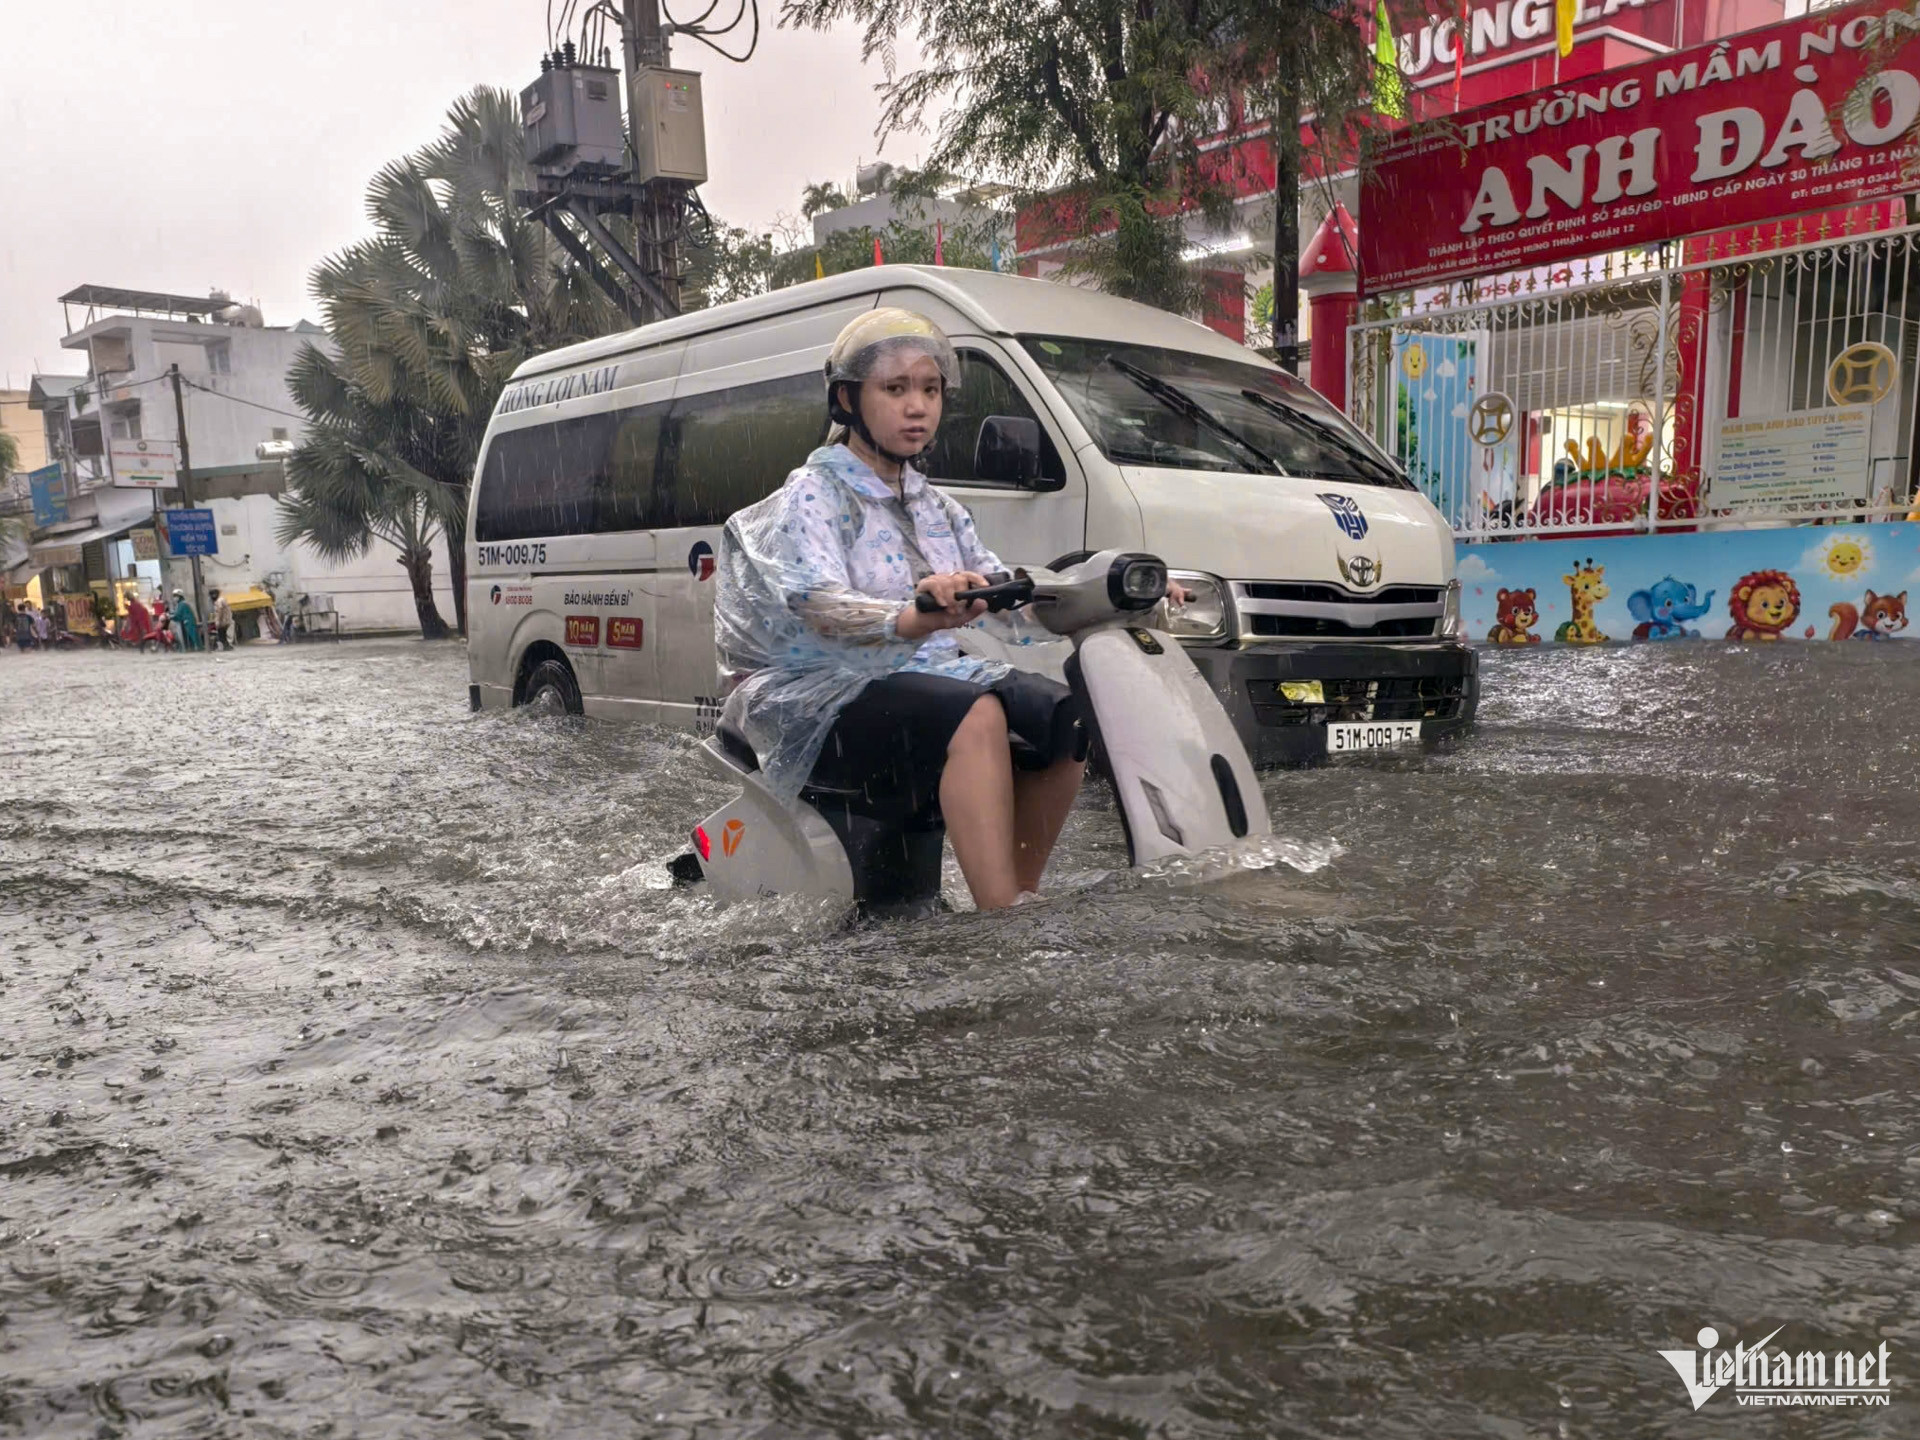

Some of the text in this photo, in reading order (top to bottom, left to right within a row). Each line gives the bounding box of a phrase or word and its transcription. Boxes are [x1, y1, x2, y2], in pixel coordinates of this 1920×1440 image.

[1461, 79, 1641, 148] TRƯỜNG
[1655, 40, 1781, 98] MẦM
[1459, 64, 1920, 233] ANH ĐÀO
[1428, 242, 1463, 258] THÀNH
[1465, 236, 1486, 251] LẬP
[1487, 231, 1515, 245] THEO
[1518, 219, 1554, 238] QUYẾT
[1556, 215, 1586, 232] ĐỊNH
[1592, 204, 1609, 223] SỐ
[1672, 190, 1709, 206] UBND
[1712, 179, 1742, 198] CẤP
[1744, 172, 1786, 191] NGÀY
[1790, 169, 1807, 182] 30
[1811, 157, 1862, 177] THÁNG
[1868, 152, 1886, 165] 12
[577, 365, 620, 398] NAM
[478, 543, 547, 566] 51M-009.75
